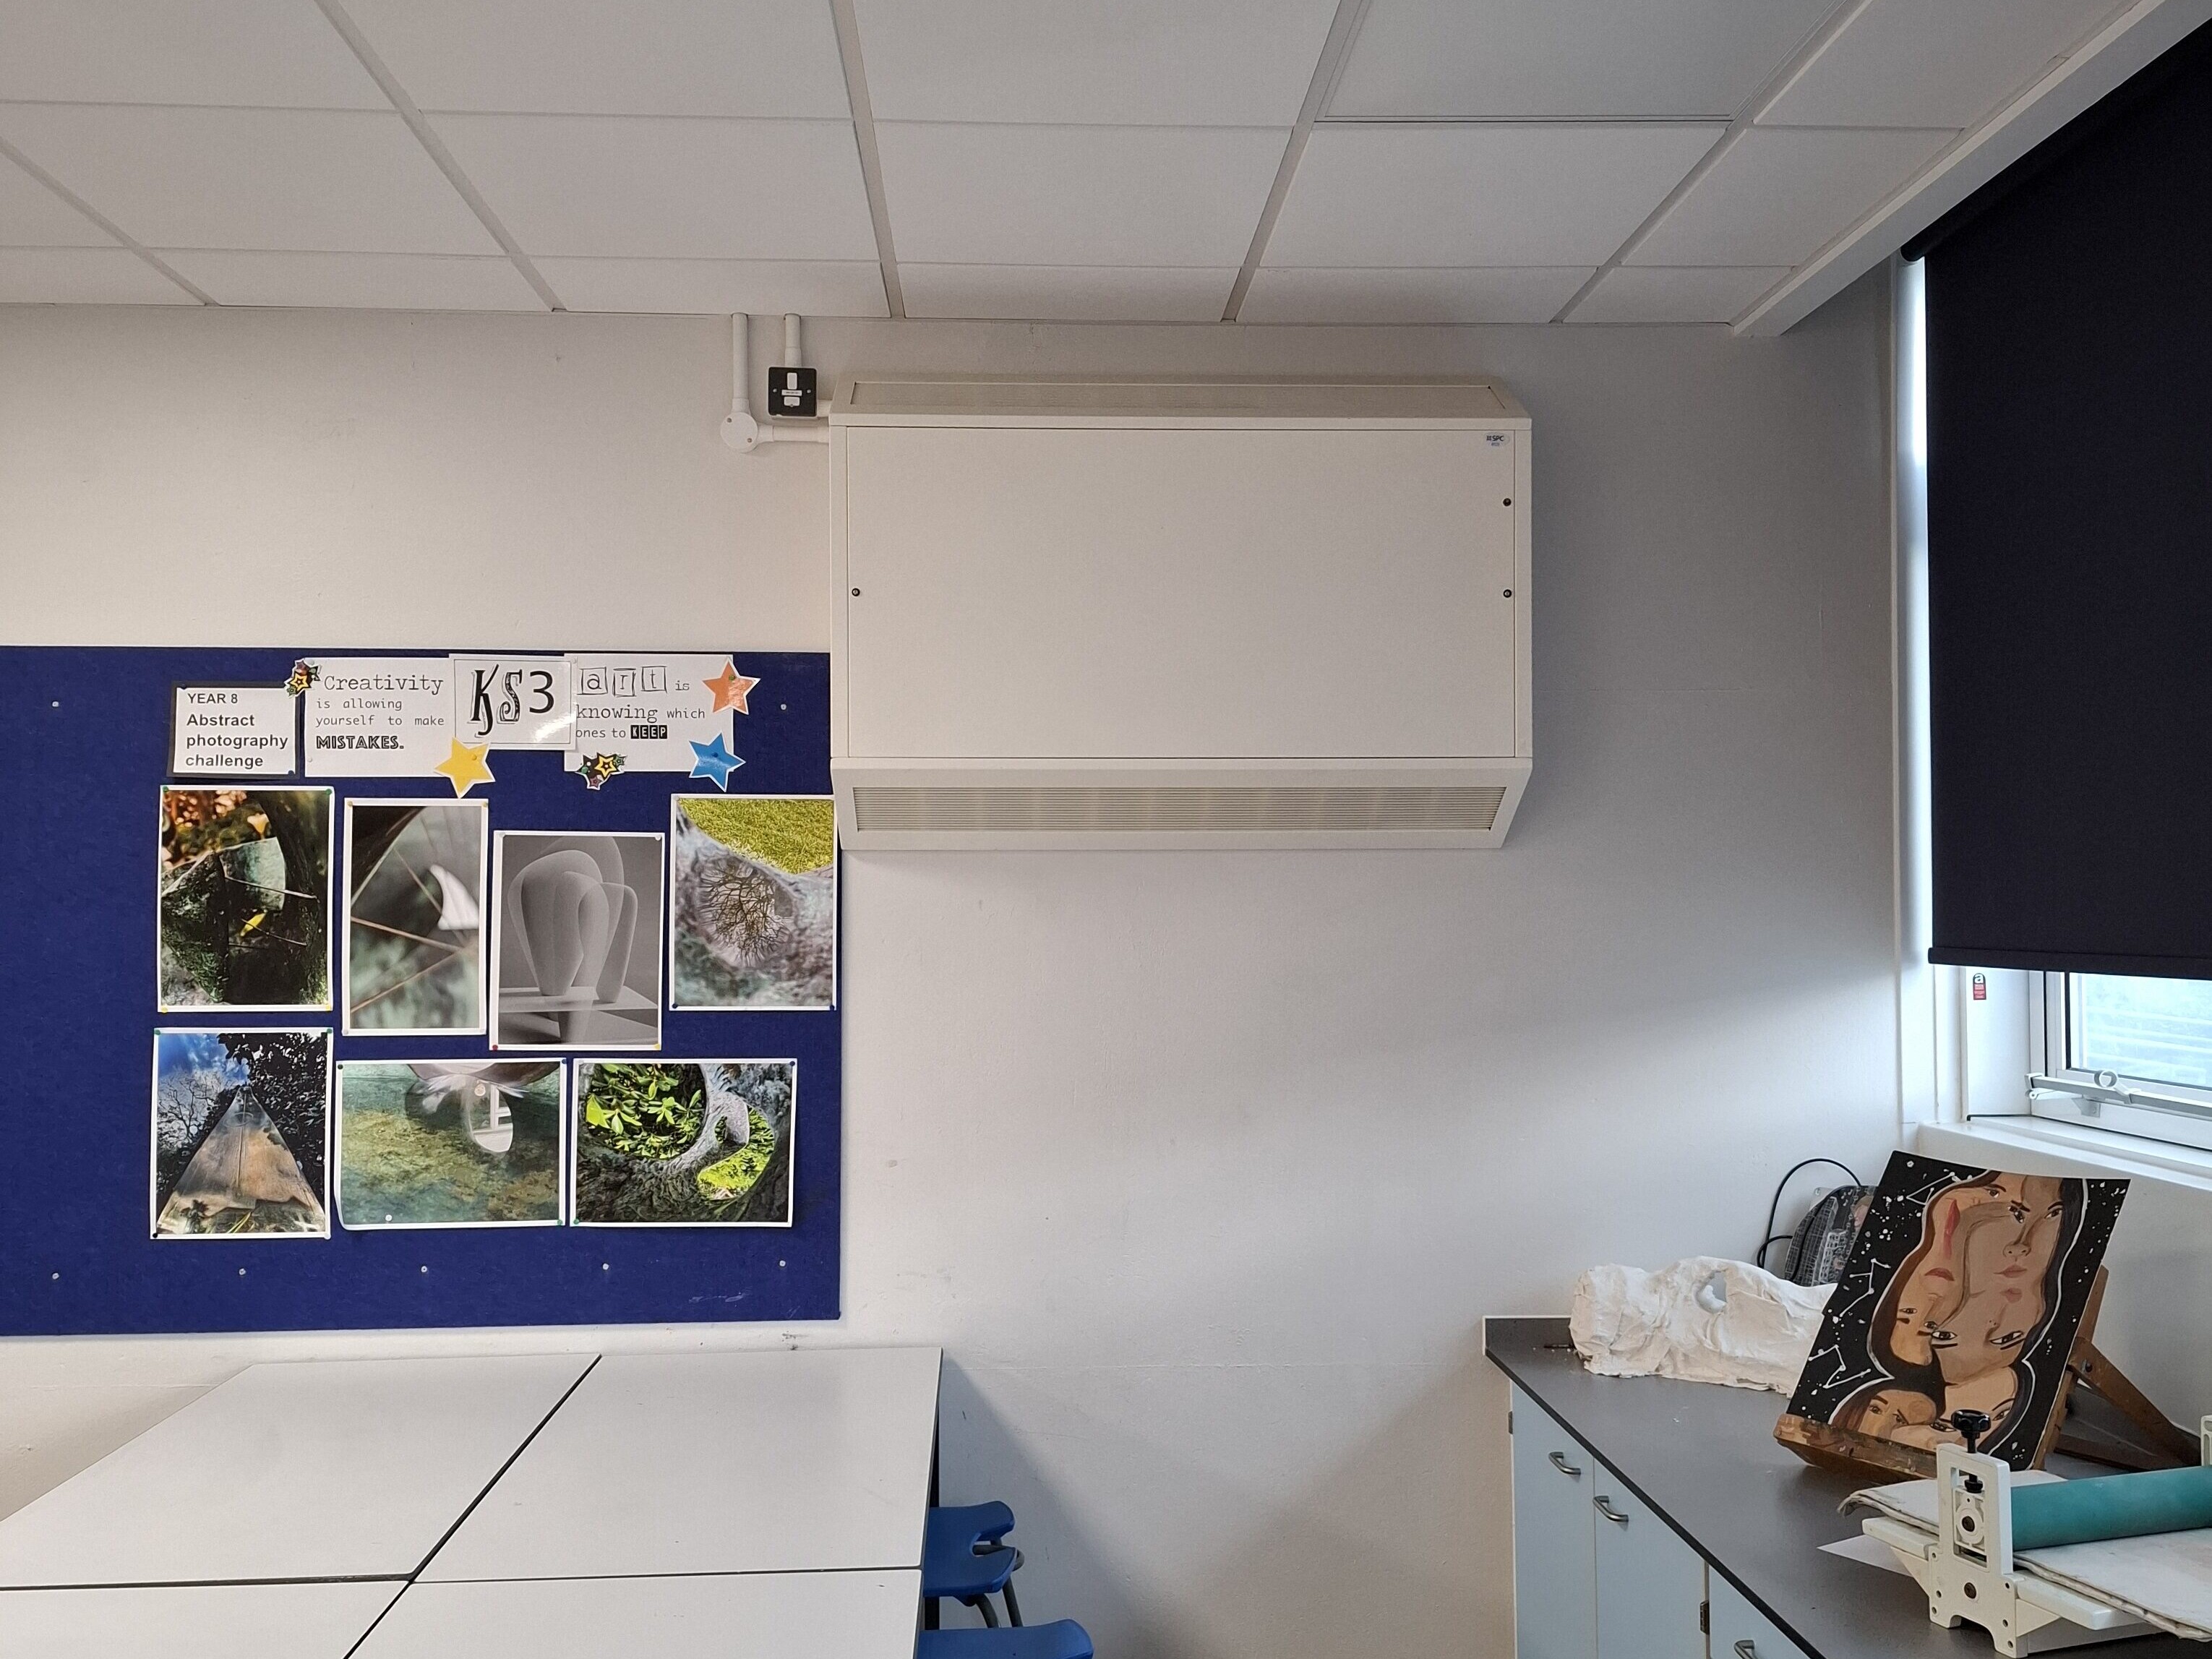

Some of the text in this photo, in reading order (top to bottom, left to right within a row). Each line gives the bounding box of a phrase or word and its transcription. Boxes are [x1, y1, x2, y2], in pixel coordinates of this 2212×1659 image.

[324, 674, 444, 695] Creativity
[674, 680, 690, 692] is
[187, 693, 239, 705] YEAR 8
[316, 697, 403, 711] is allowing
[468, 663, 555, 738] KS3
[187, 713, 255, 726] Abstract
[315, 714, 445, 728] yourself to make
[576, 704, 706, 724] knowing which
[576, 726, 667, 739] ones to KEEP
[186, 734, 288, 750] photography
[315, 735, 405, 750] MISTAKES.
[185, 754, 264, 770] challenge
